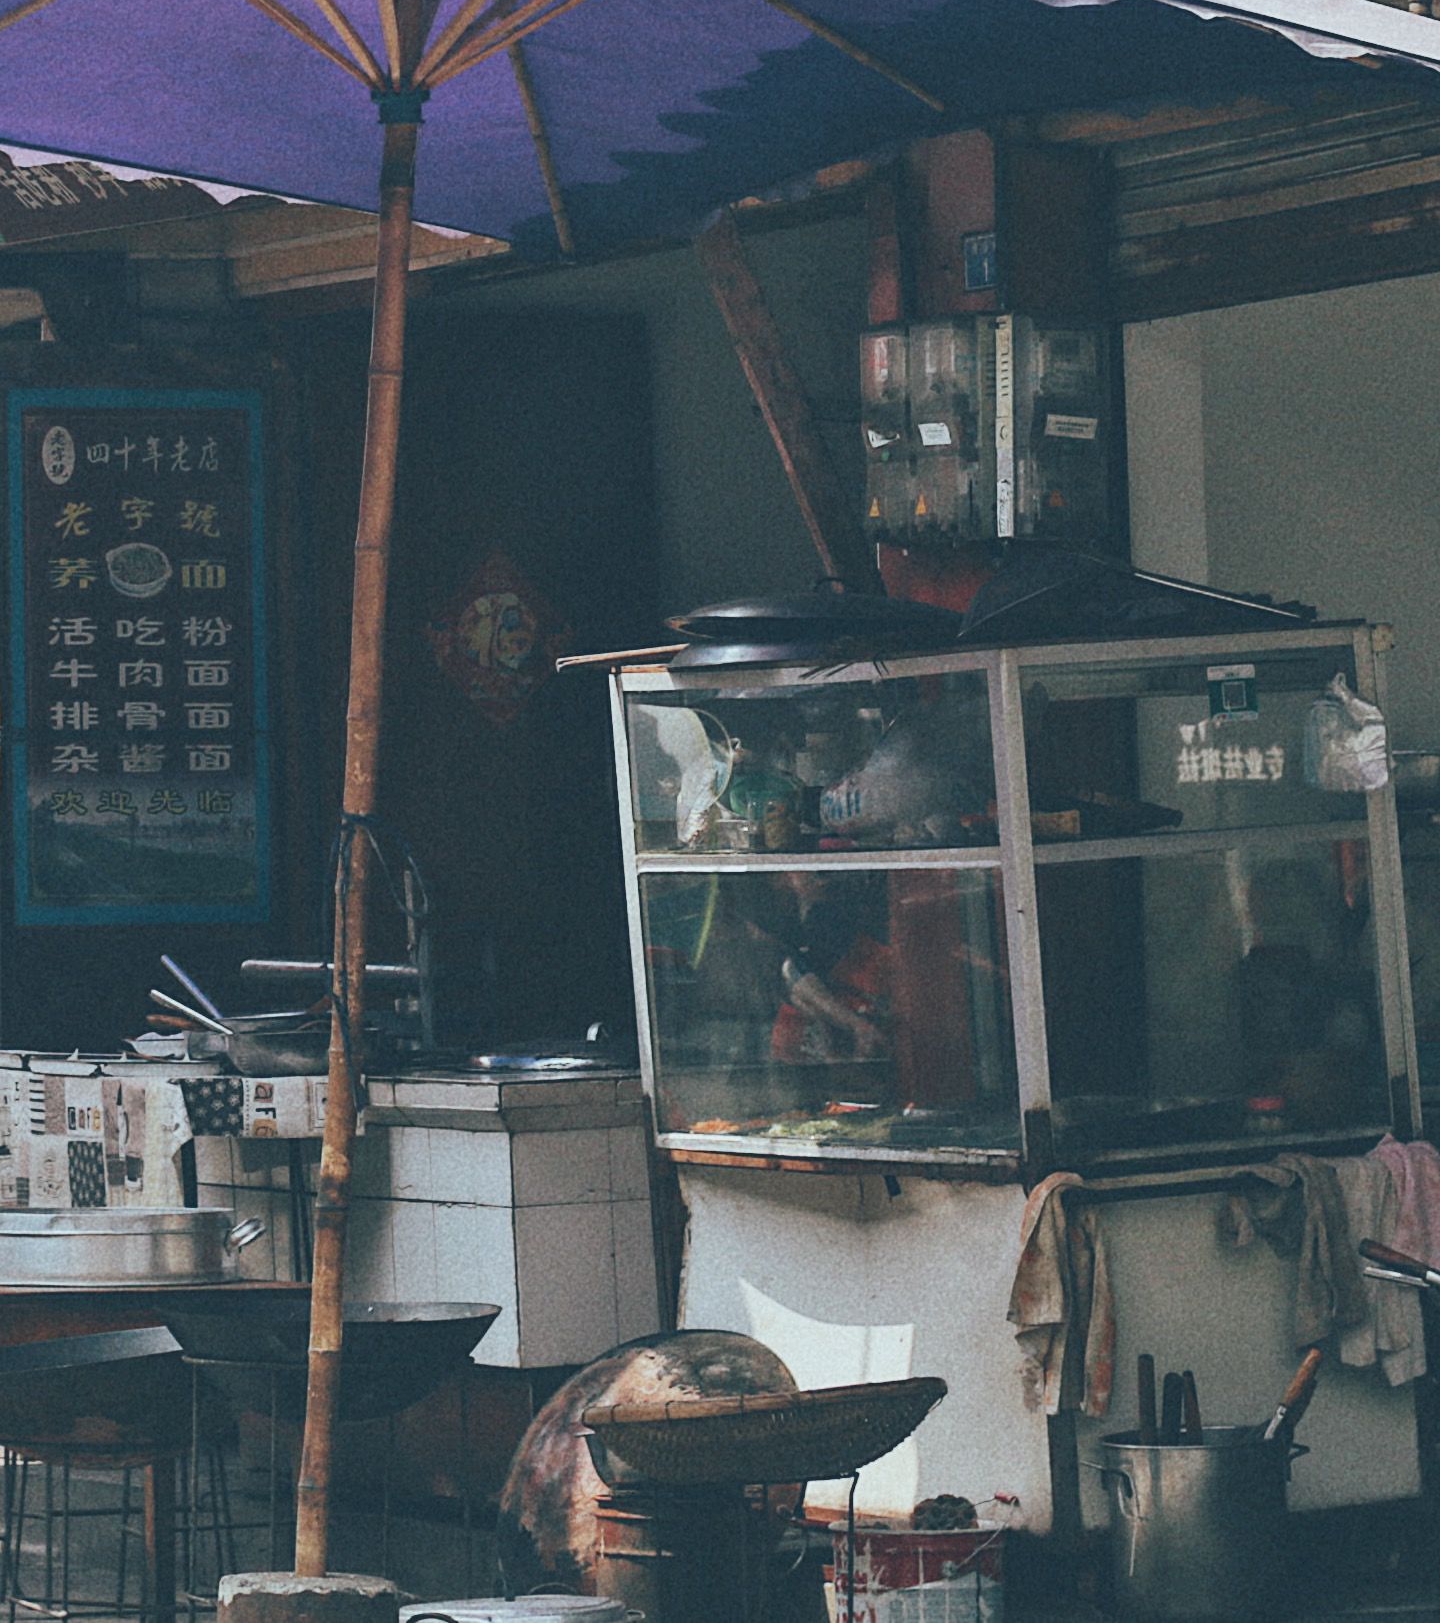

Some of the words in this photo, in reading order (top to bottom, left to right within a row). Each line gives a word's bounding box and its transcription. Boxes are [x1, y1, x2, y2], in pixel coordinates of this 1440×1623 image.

[86, 434, 219, 473] 四十年老店
[48, 616, 233, 647] 活吃粉
[49, 658, 232, 688] 牛肉面
[50, 701, 234, 731] 排骨面
[51, 743, 233, 773] 杂酱面
[50, 787, 235, 815] 欢迎光临
